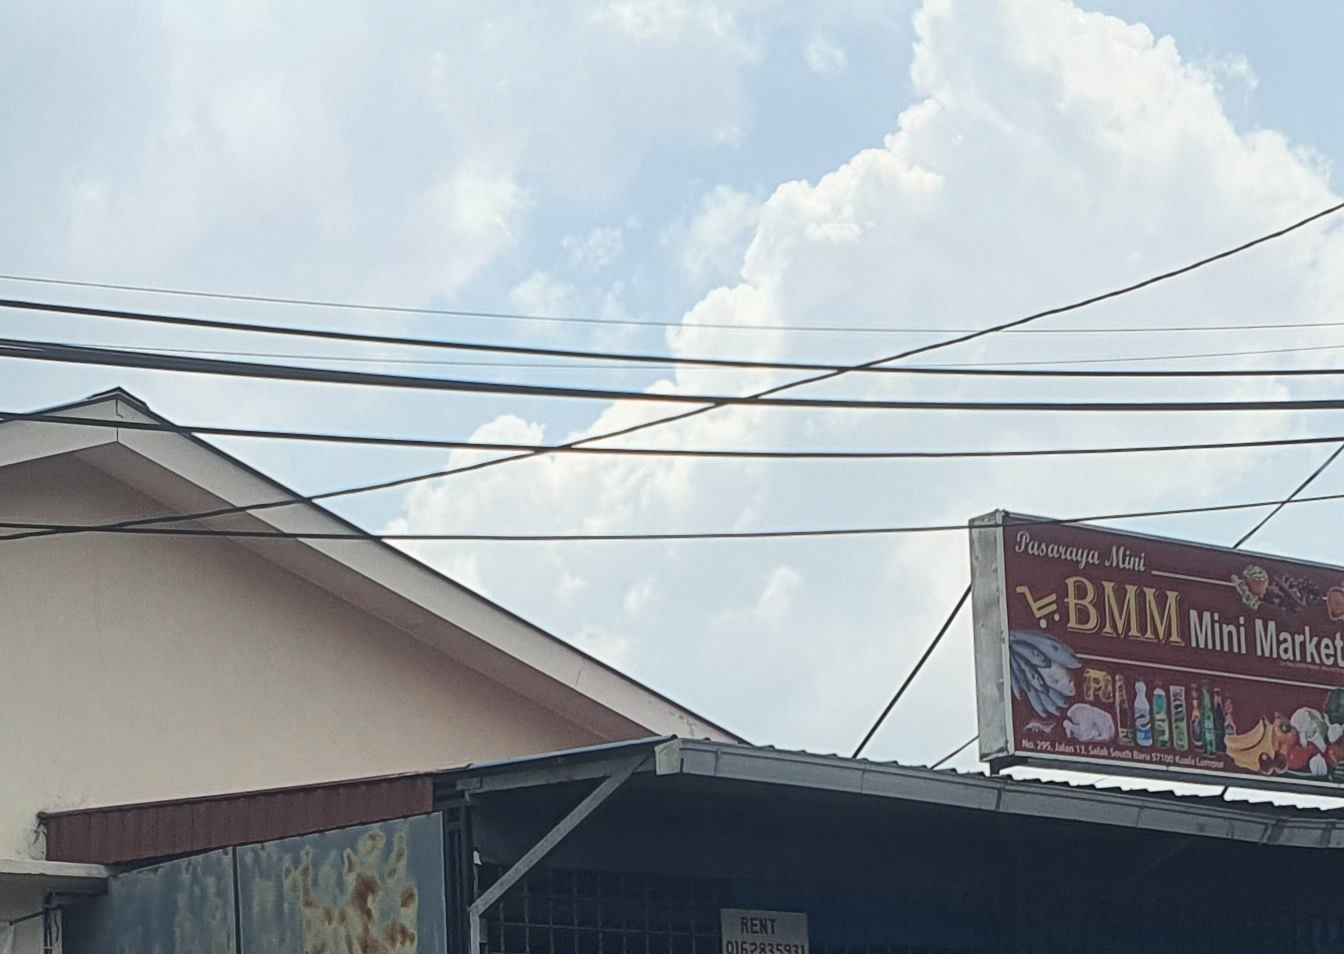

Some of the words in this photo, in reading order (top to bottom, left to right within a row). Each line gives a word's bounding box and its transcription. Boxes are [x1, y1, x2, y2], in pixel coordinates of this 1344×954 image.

[1015, 530, 1100, 569] Pasaraya
[1105, 544, 1146, 572] Mini
[1064, 576, 1186, 646] BMM
[1189, 609, 1247, 654] Mini
[1022, 739, 1036, 749] No.
[1055, 742, 1074, 753] Jalan
[1089, 745, 1109, 756] Salak
[1110, 748, 1132, 759] South
[1133, 751, 1150, 761] Baru
[1152, 753, 1174, 763] 57100
[1176, 755, 1196, 766] Kuala
[1196, 757, 1225, 768] Lumpur
[740, 917, 776, 935] RENT
